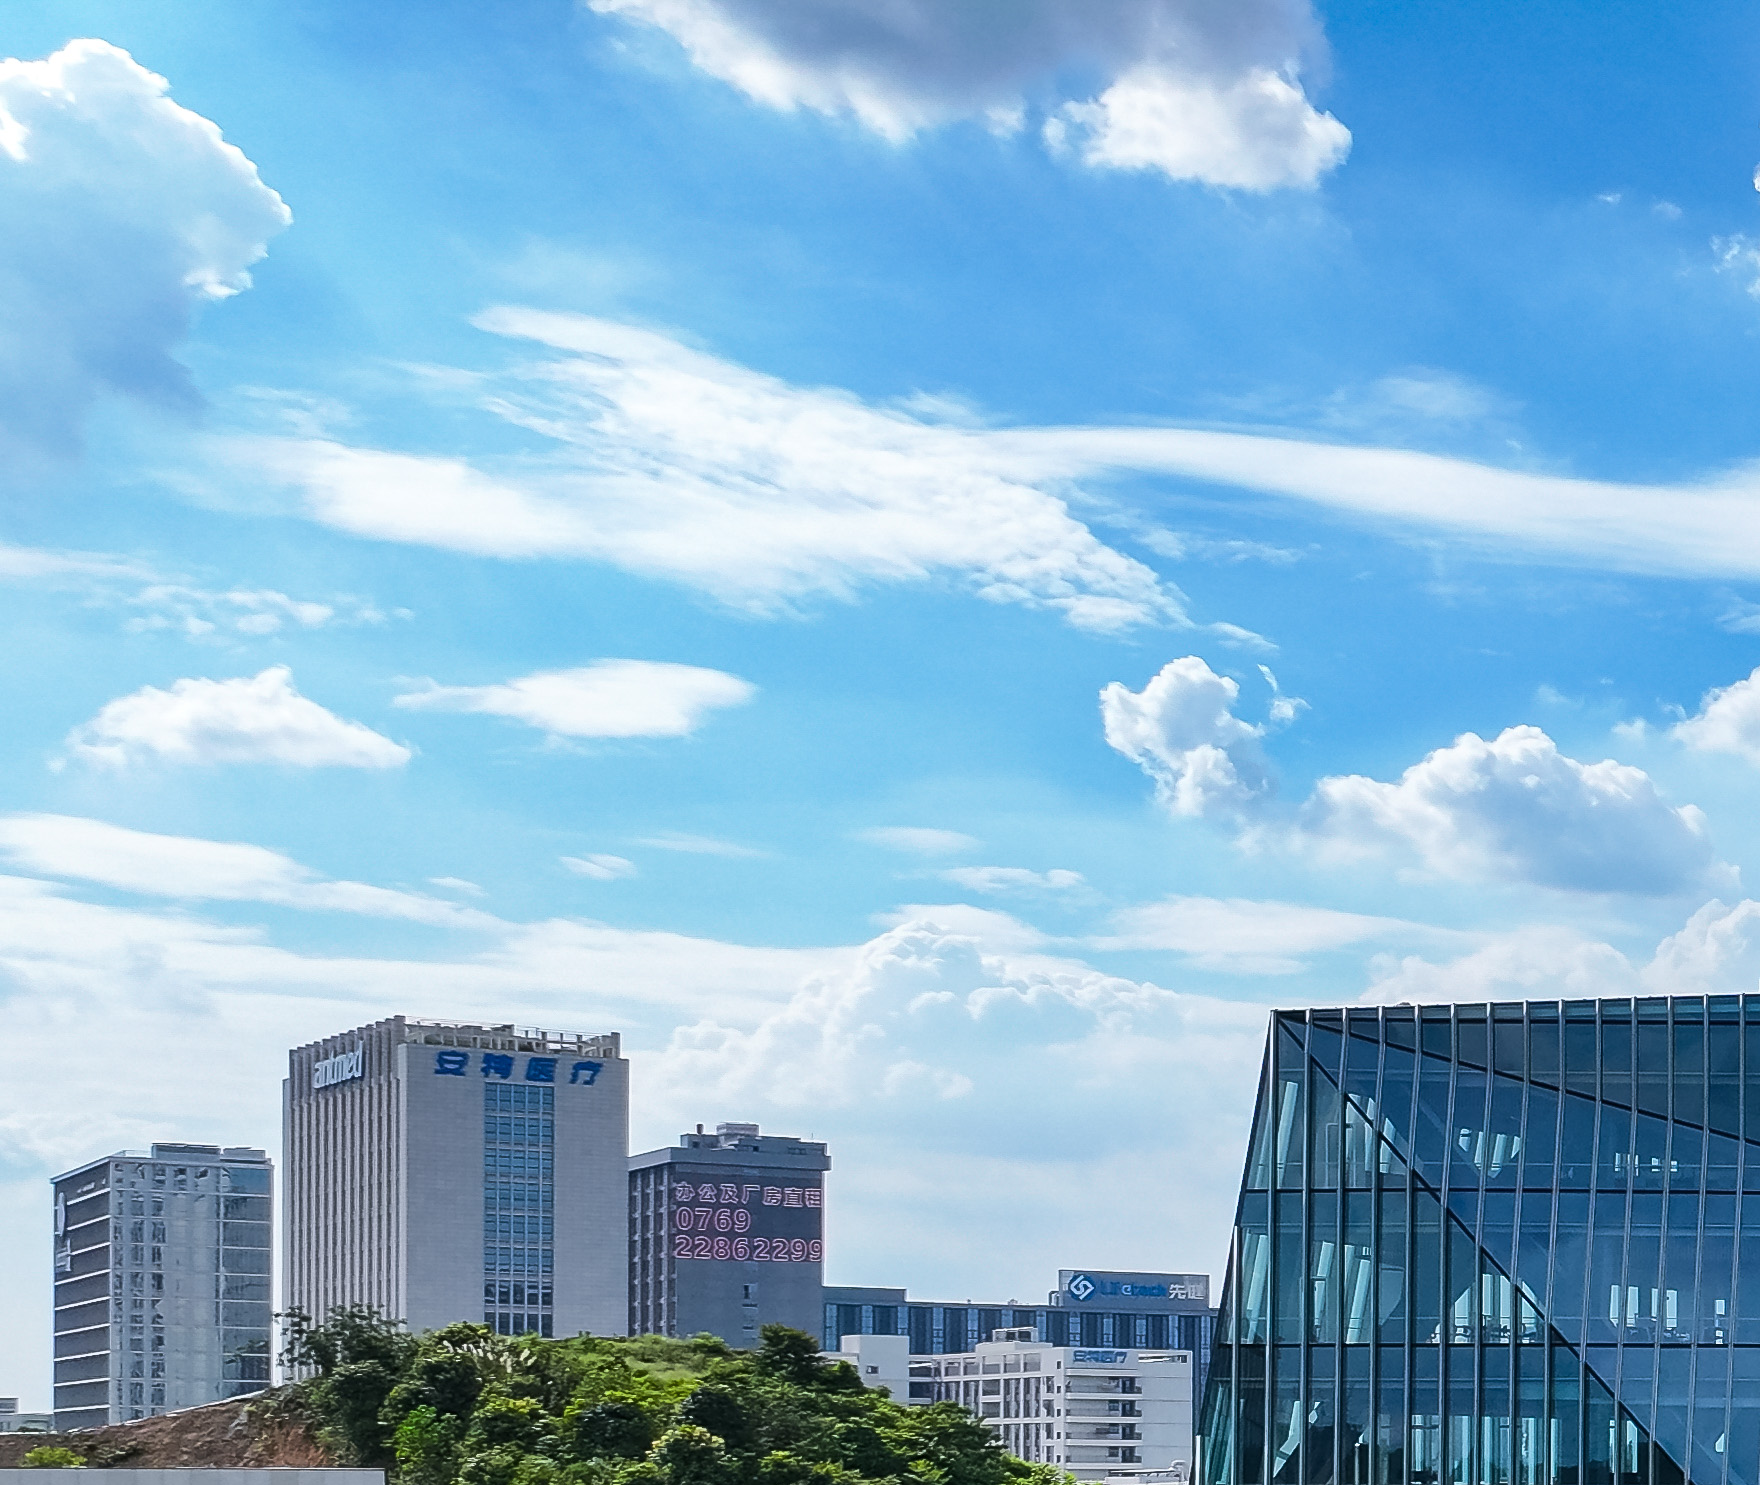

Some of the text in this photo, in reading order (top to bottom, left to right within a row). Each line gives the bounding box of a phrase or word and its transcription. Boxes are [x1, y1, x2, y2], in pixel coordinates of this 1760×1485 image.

[313, 1040, 363, 1089] antmed
[676, 1206, 751, 1232] 0769
[675, 1234, 822, 1262] 22862299
